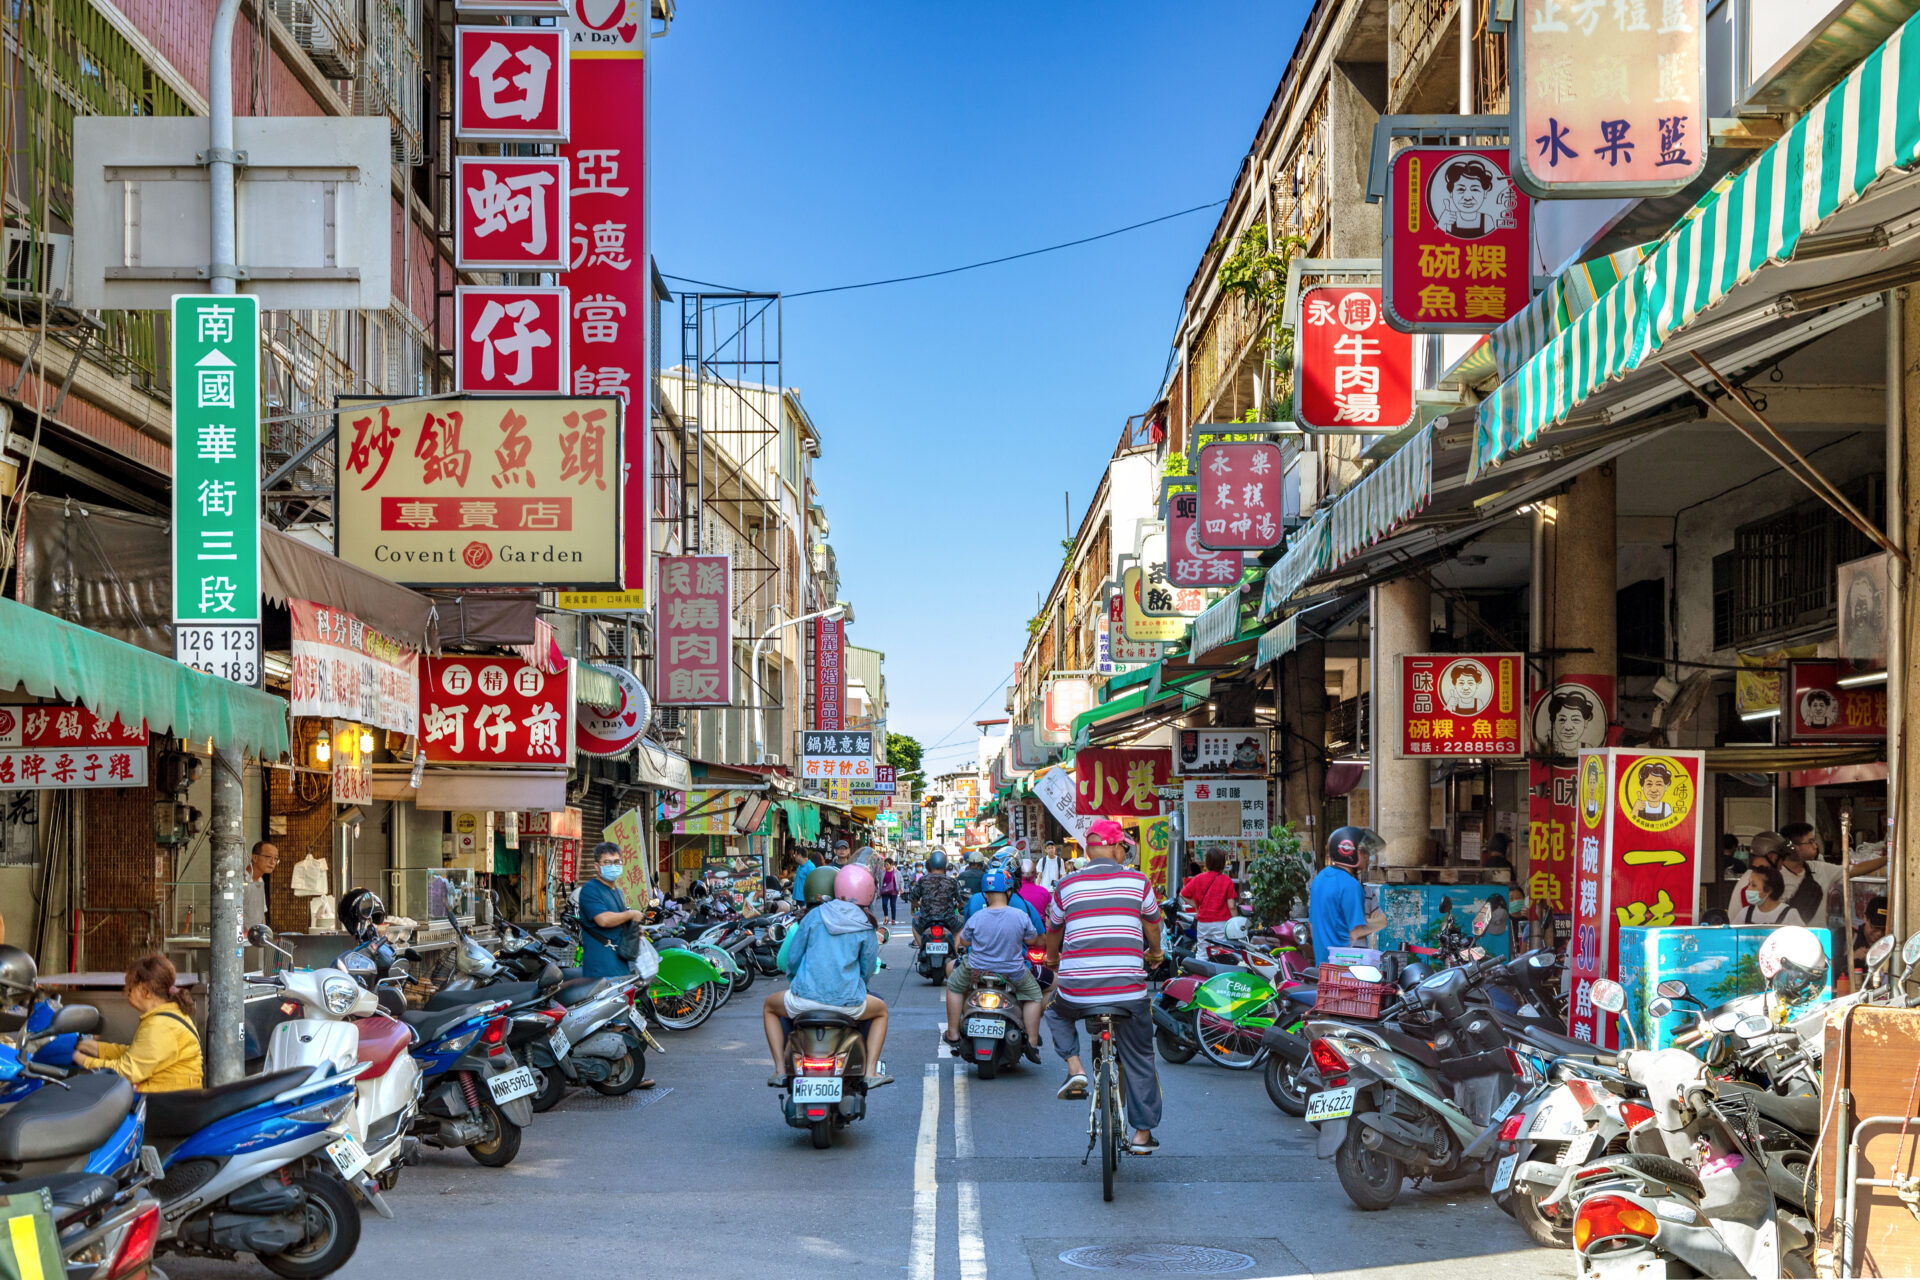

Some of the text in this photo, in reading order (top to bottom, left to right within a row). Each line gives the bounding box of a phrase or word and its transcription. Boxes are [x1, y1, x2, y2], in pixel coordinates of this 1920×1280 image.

[591, 32, 619, 45] Day
[1535, 116, 1693, 167] 水果籃
[1418, 243, 1507, 279] 碗粿
[1417, 283, 1506, 319] 魚羹
[196, 305, 235, 344] 南
[1333, 334, 1382, 422] 牛肉湯
[345, 405, 611, 491] 砂鍋魚頭
[1208, 449, 1272, 476] 永樂
[196, 370, 239, 613] 國華街三段
[396, 501, 563, 529] 專賣店
[1205, 512, 1277, 541] 四神湯
[374, 543, 584, 563] Covent Garden
[1176, 559, 1235, 581] 好茶
[662, 562, 724, 595] 民族
[180, 630, 255, 651] 126 123
[316, 608, 364, 651] 科芬園
[668, 598, 720, 700] 燒肉飯
[221, 662, 255, 682] 183
[447, 669, 541, 692] 石精臼
[1412, 661, 1434, 714] 一味品
[422, 702, 562, 758] 蚵仔煎
[602, 720, 624, 730] Day
[806, 735, 870, 754] 鍋燒意麵
[806, 759, 870, 776] 荷芽飲品
[1079, 759, 1160, 811] 小卷
[1194, 784, 1211, 799] 春
[1580, 836, 1600, 918] 碗粿
[1577, 924, 1596, 972] 30
